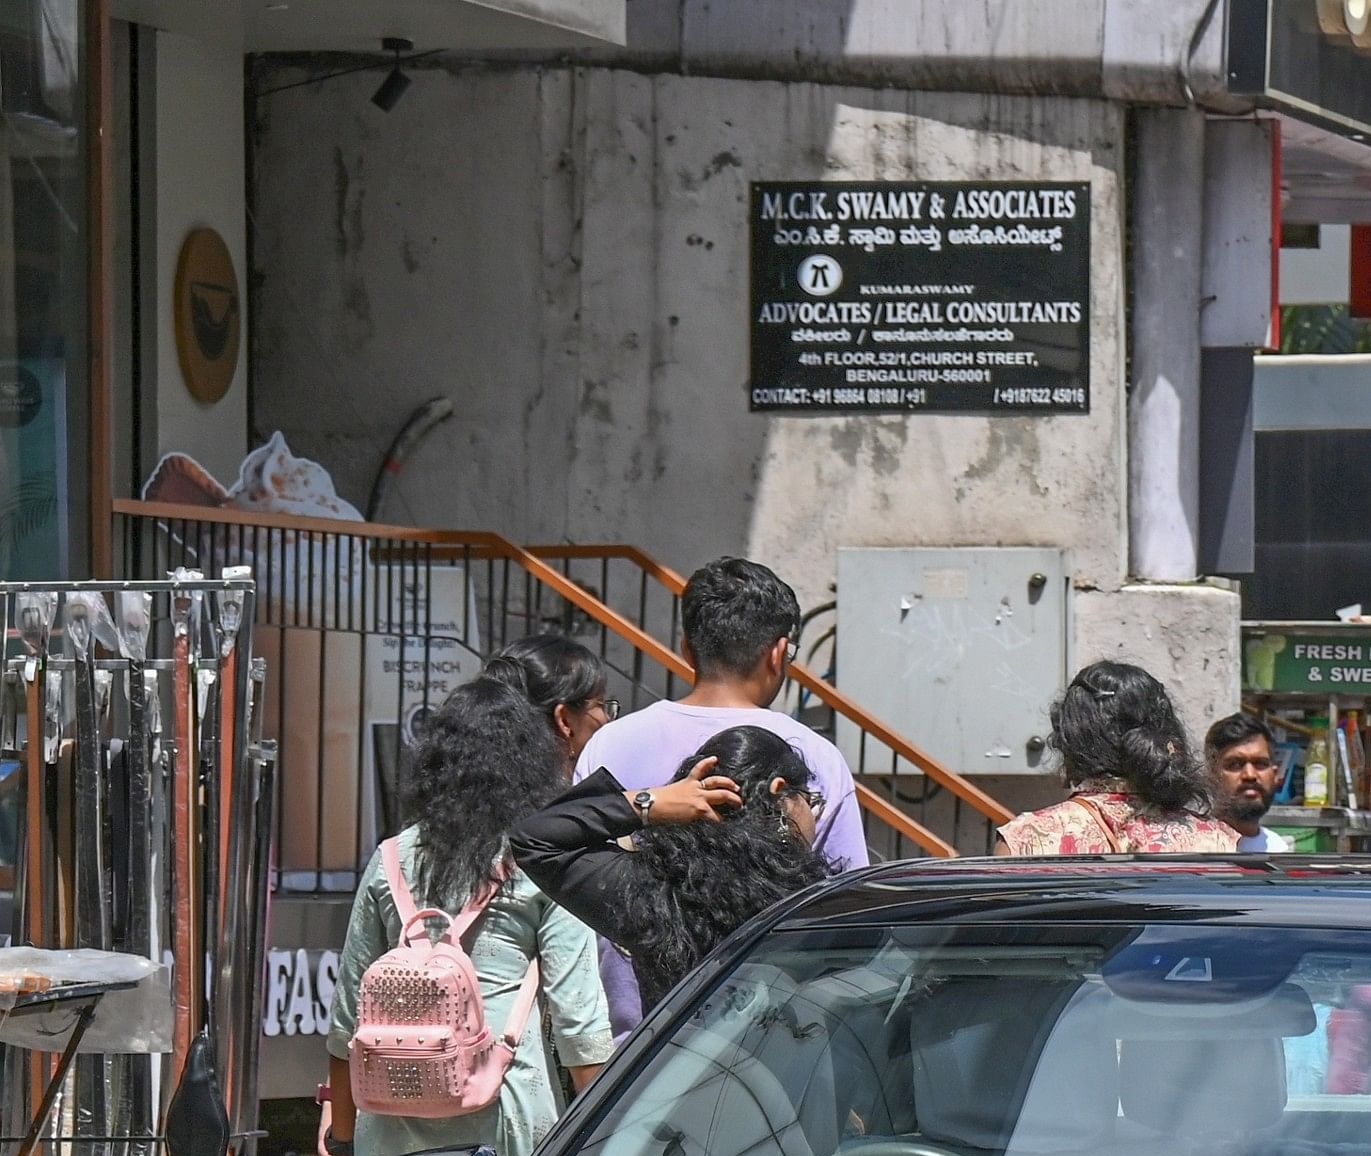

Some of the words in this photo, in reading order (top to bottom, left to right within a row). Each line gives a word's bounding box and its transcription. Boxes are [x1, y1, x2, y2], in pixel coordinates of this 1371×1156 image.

[760, 192, 833, 220] M.C.K.
[837, 191, 926, 220] SWAMY
[929, 192, 945, 219] &
[952, 190, 1076, 219] ASSOCIATES
[860, 284, 975, 295] KUMARASWAMY
[759, 302, 871, 324] ADVOCATES
[885, 302, 944, 323] LEGAL
[946, 301, 1082, 323] CONSULTANTS
[798, 352, 823, 366] 4th
[976, 352, 1039, 367] STREET,
[845, 369, 991, 382] BENGALURU-560001
[752, 388, 811, 404] CONTACT:
[1294, 644, 1362, 660] FRESH
[1307, 667, 1323, 682] &
